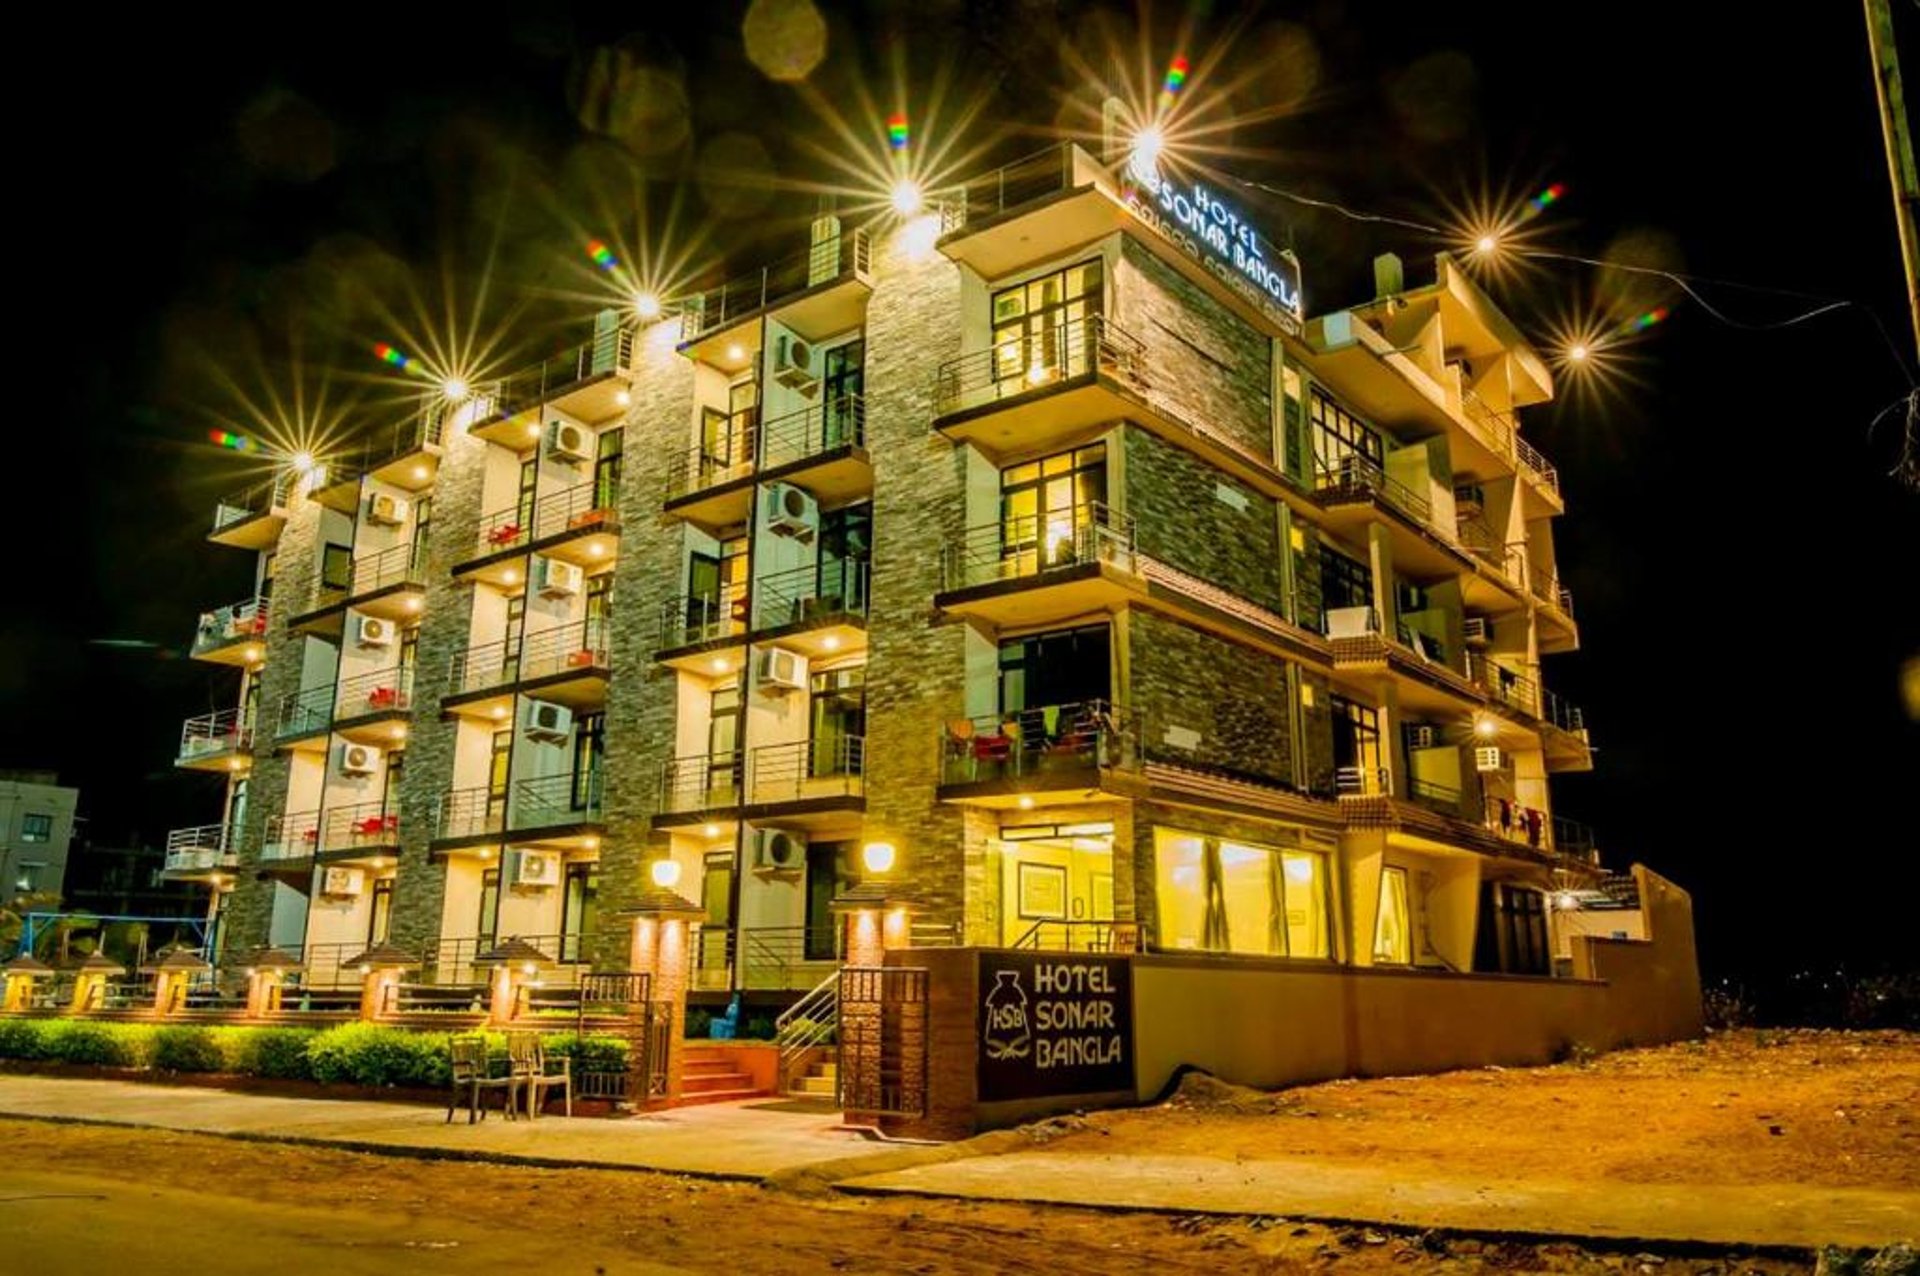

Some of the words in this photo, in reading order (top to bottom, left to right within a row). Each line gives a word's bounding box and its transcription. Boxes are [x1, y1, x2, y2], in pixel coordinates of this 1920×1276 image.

[1195, 185, 1262, 257] HOTEL
[1161, 182, 1229, 256] SONAR
[1233, 243, 1299, 315] BANGLA
[1034, 964, 1116, 993] HOTEL
[993, 1004, 1023, 1029] HSB
[1035, 1001, 1115, 1030] SONAR
[1036, 1035, 1122, 1068] BANGLA
